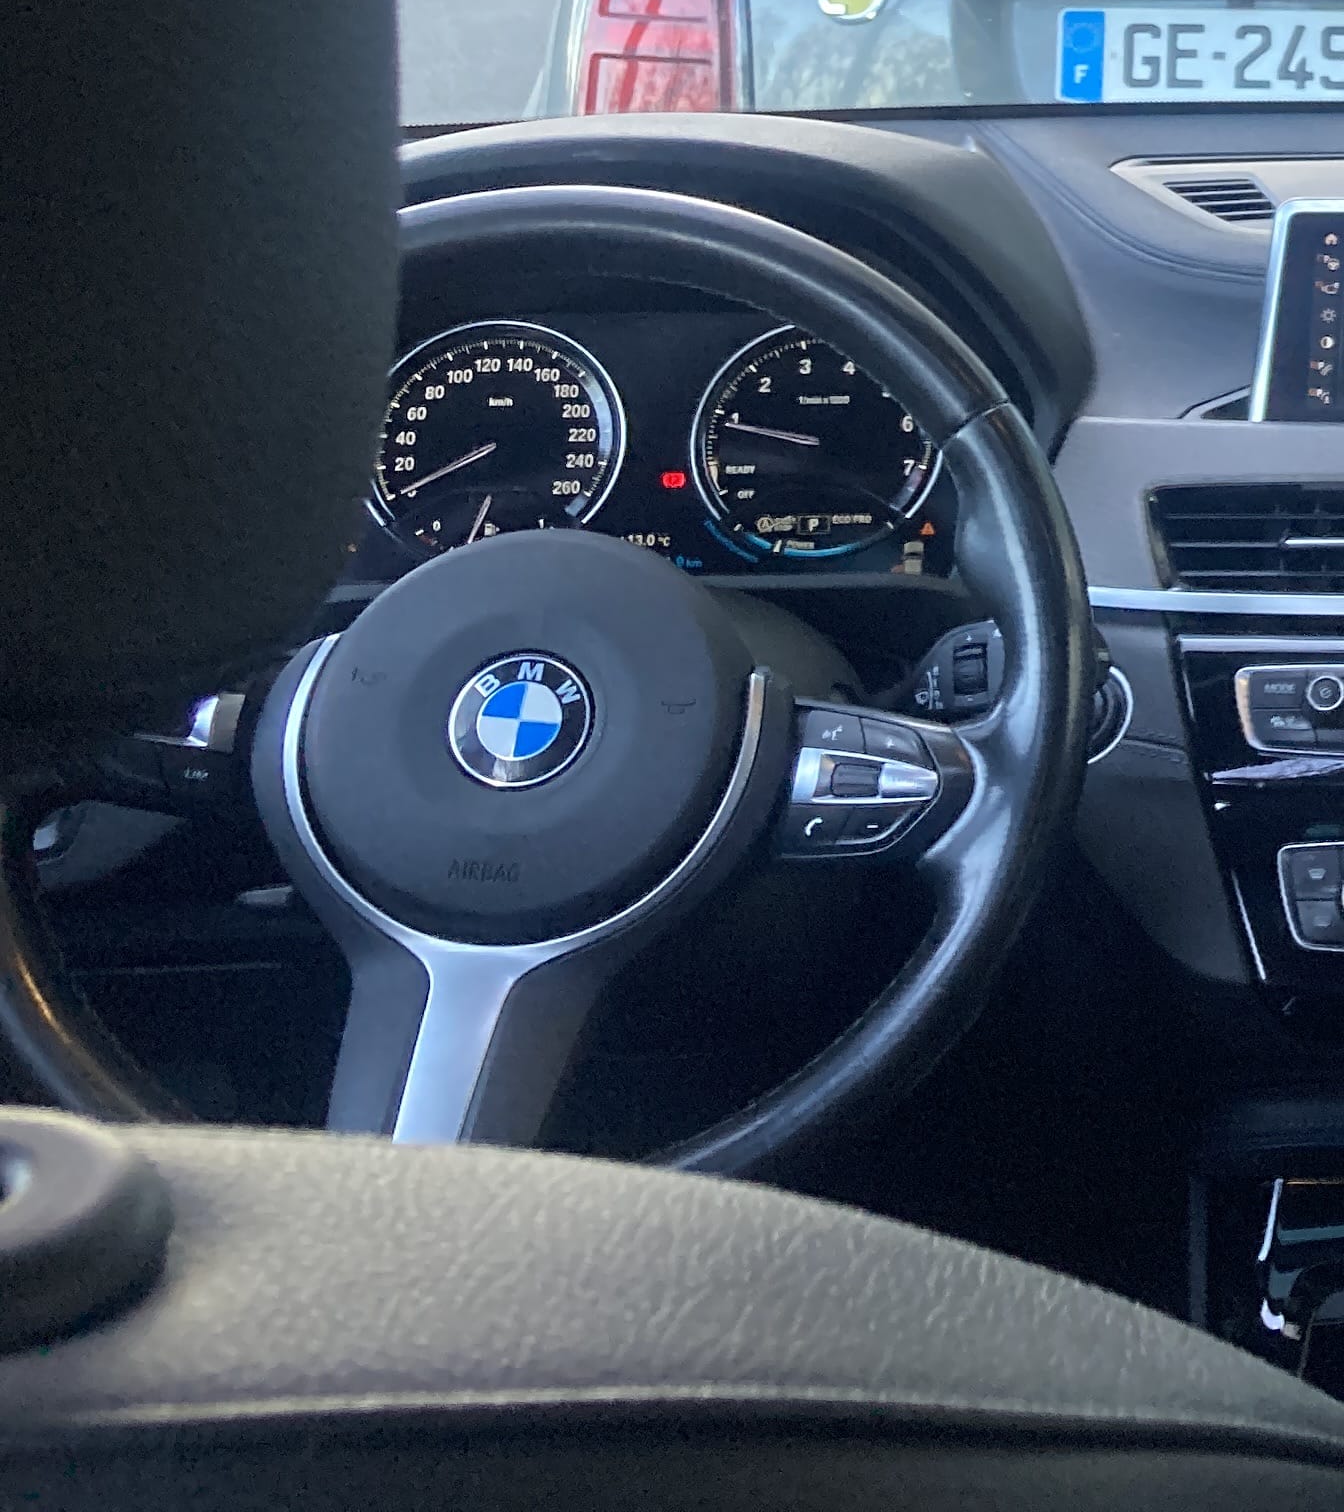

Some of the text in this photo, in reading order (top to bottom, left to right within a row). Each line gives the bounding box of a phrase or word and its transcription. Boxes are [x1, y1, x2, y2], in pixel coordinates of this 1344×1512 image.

[1074, 65, 1088, 84] F
[474, 357, 502, 373] 120
[506, 357, 534, 373] 140
[799, 358, 812, 375] 3
[842, 360, 856, 376] 4
[446, 369, 473, 384] 100
[533, 367, 561, 382] 160
[424, 385, 445, 400] 80
[553, 384, 580, 399] 180
[758, 377, 772, 394] 2
[488, 396, 514, 408] km/h
[406, 405, 428, 421] 60
[561, 403, 591, 419] 200
[902, 415, 914, 433] 6
[395, 431, 417, 446] 40
[568, 427, 597, 443] 220
[394, 456, 416, 472] 20
[565, 453, 595, 469] 240
[903, 459, 916, 476] 7
[551, 480, 581, 496] 260
[432, 519, 442, 532] 0
[474, 661, 581, 705] BMW
[447, 857, 520, 884] AIRBAG
